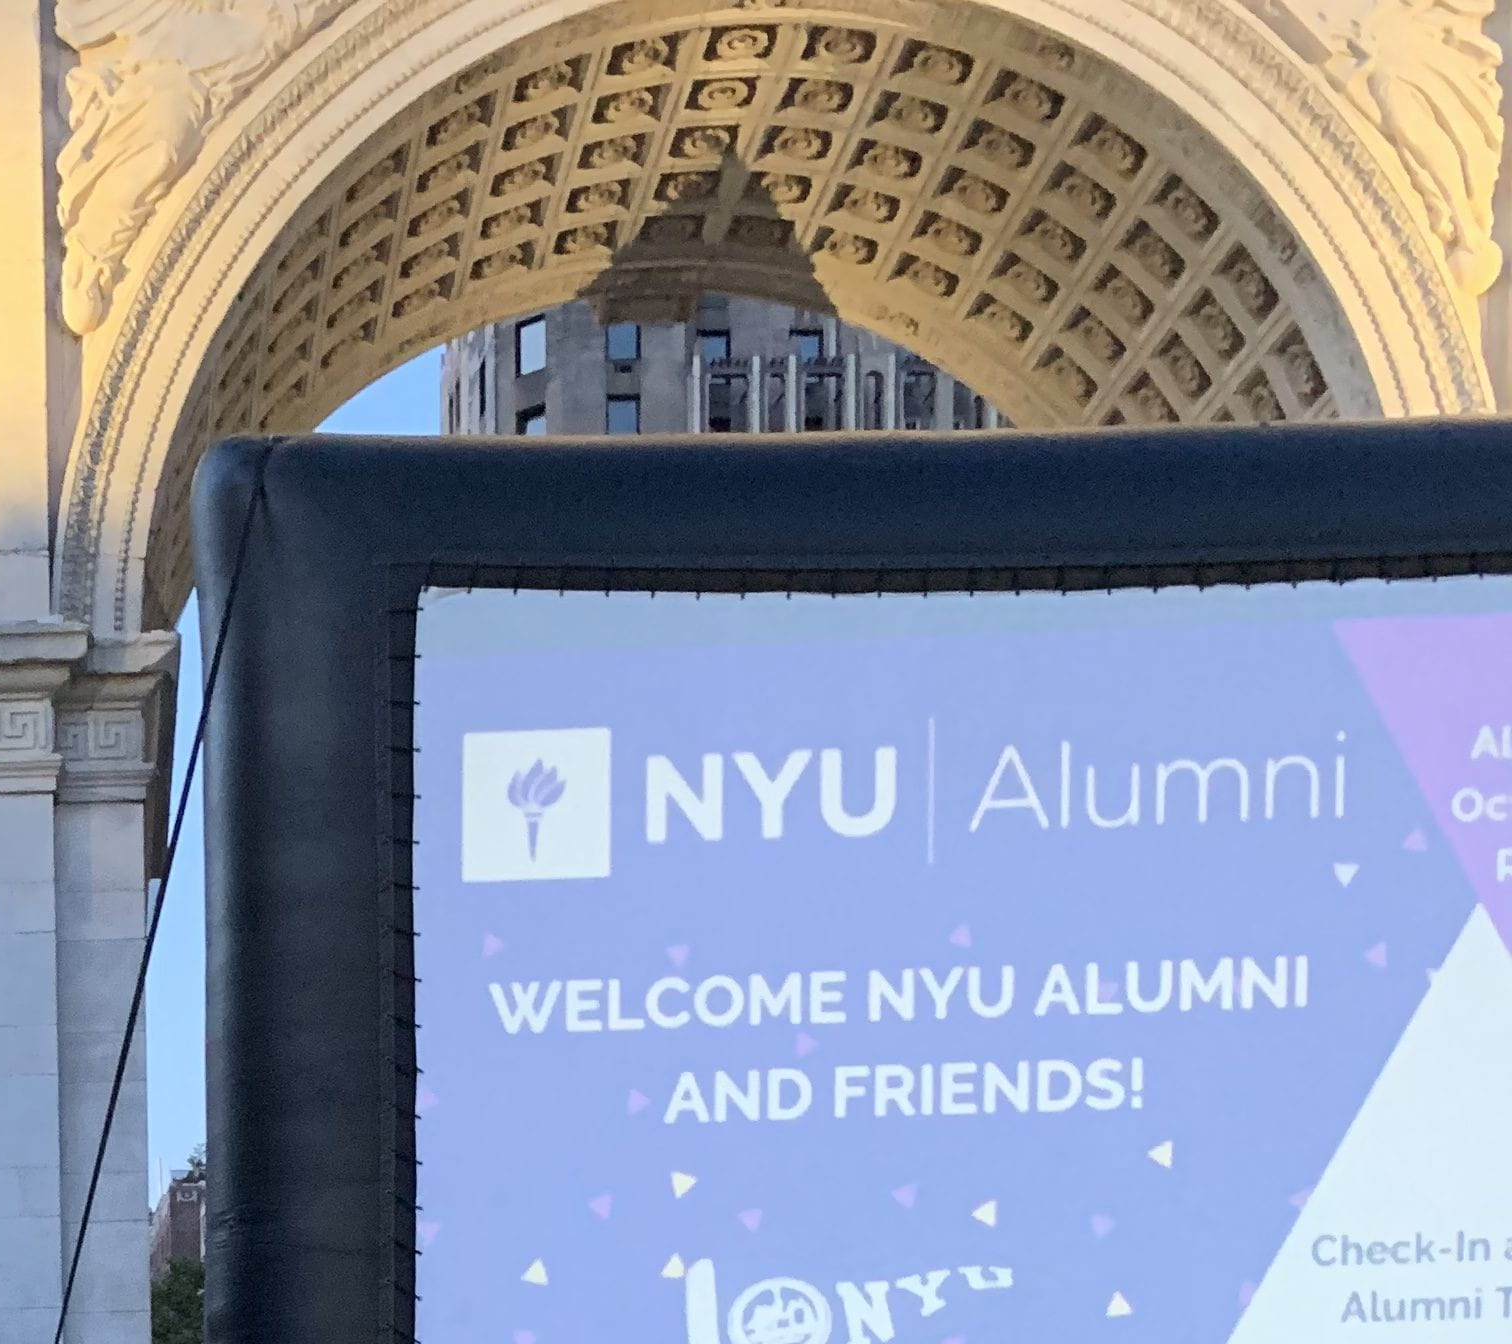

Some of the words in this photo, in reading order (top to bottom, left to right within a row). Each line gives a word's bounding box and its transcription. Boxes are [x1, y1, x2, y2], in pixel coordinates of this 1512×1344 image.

[644, 745, 898, 844] NYU
[967, 730, 1348, 834] Alumni
[489, 968, 847, 1035] WELCOME
[867, 966, 1014, 1024] NYU
[1033, 955, 1311, 1019] ALUMNI
[663, 1065, 813, 1125] AND
[833, 1055, 1146, 1120] FRIENDS!
[1311, 1229, 1491, 1268] Check-In
[1341, 1286, 1483, 1323] Alumni
